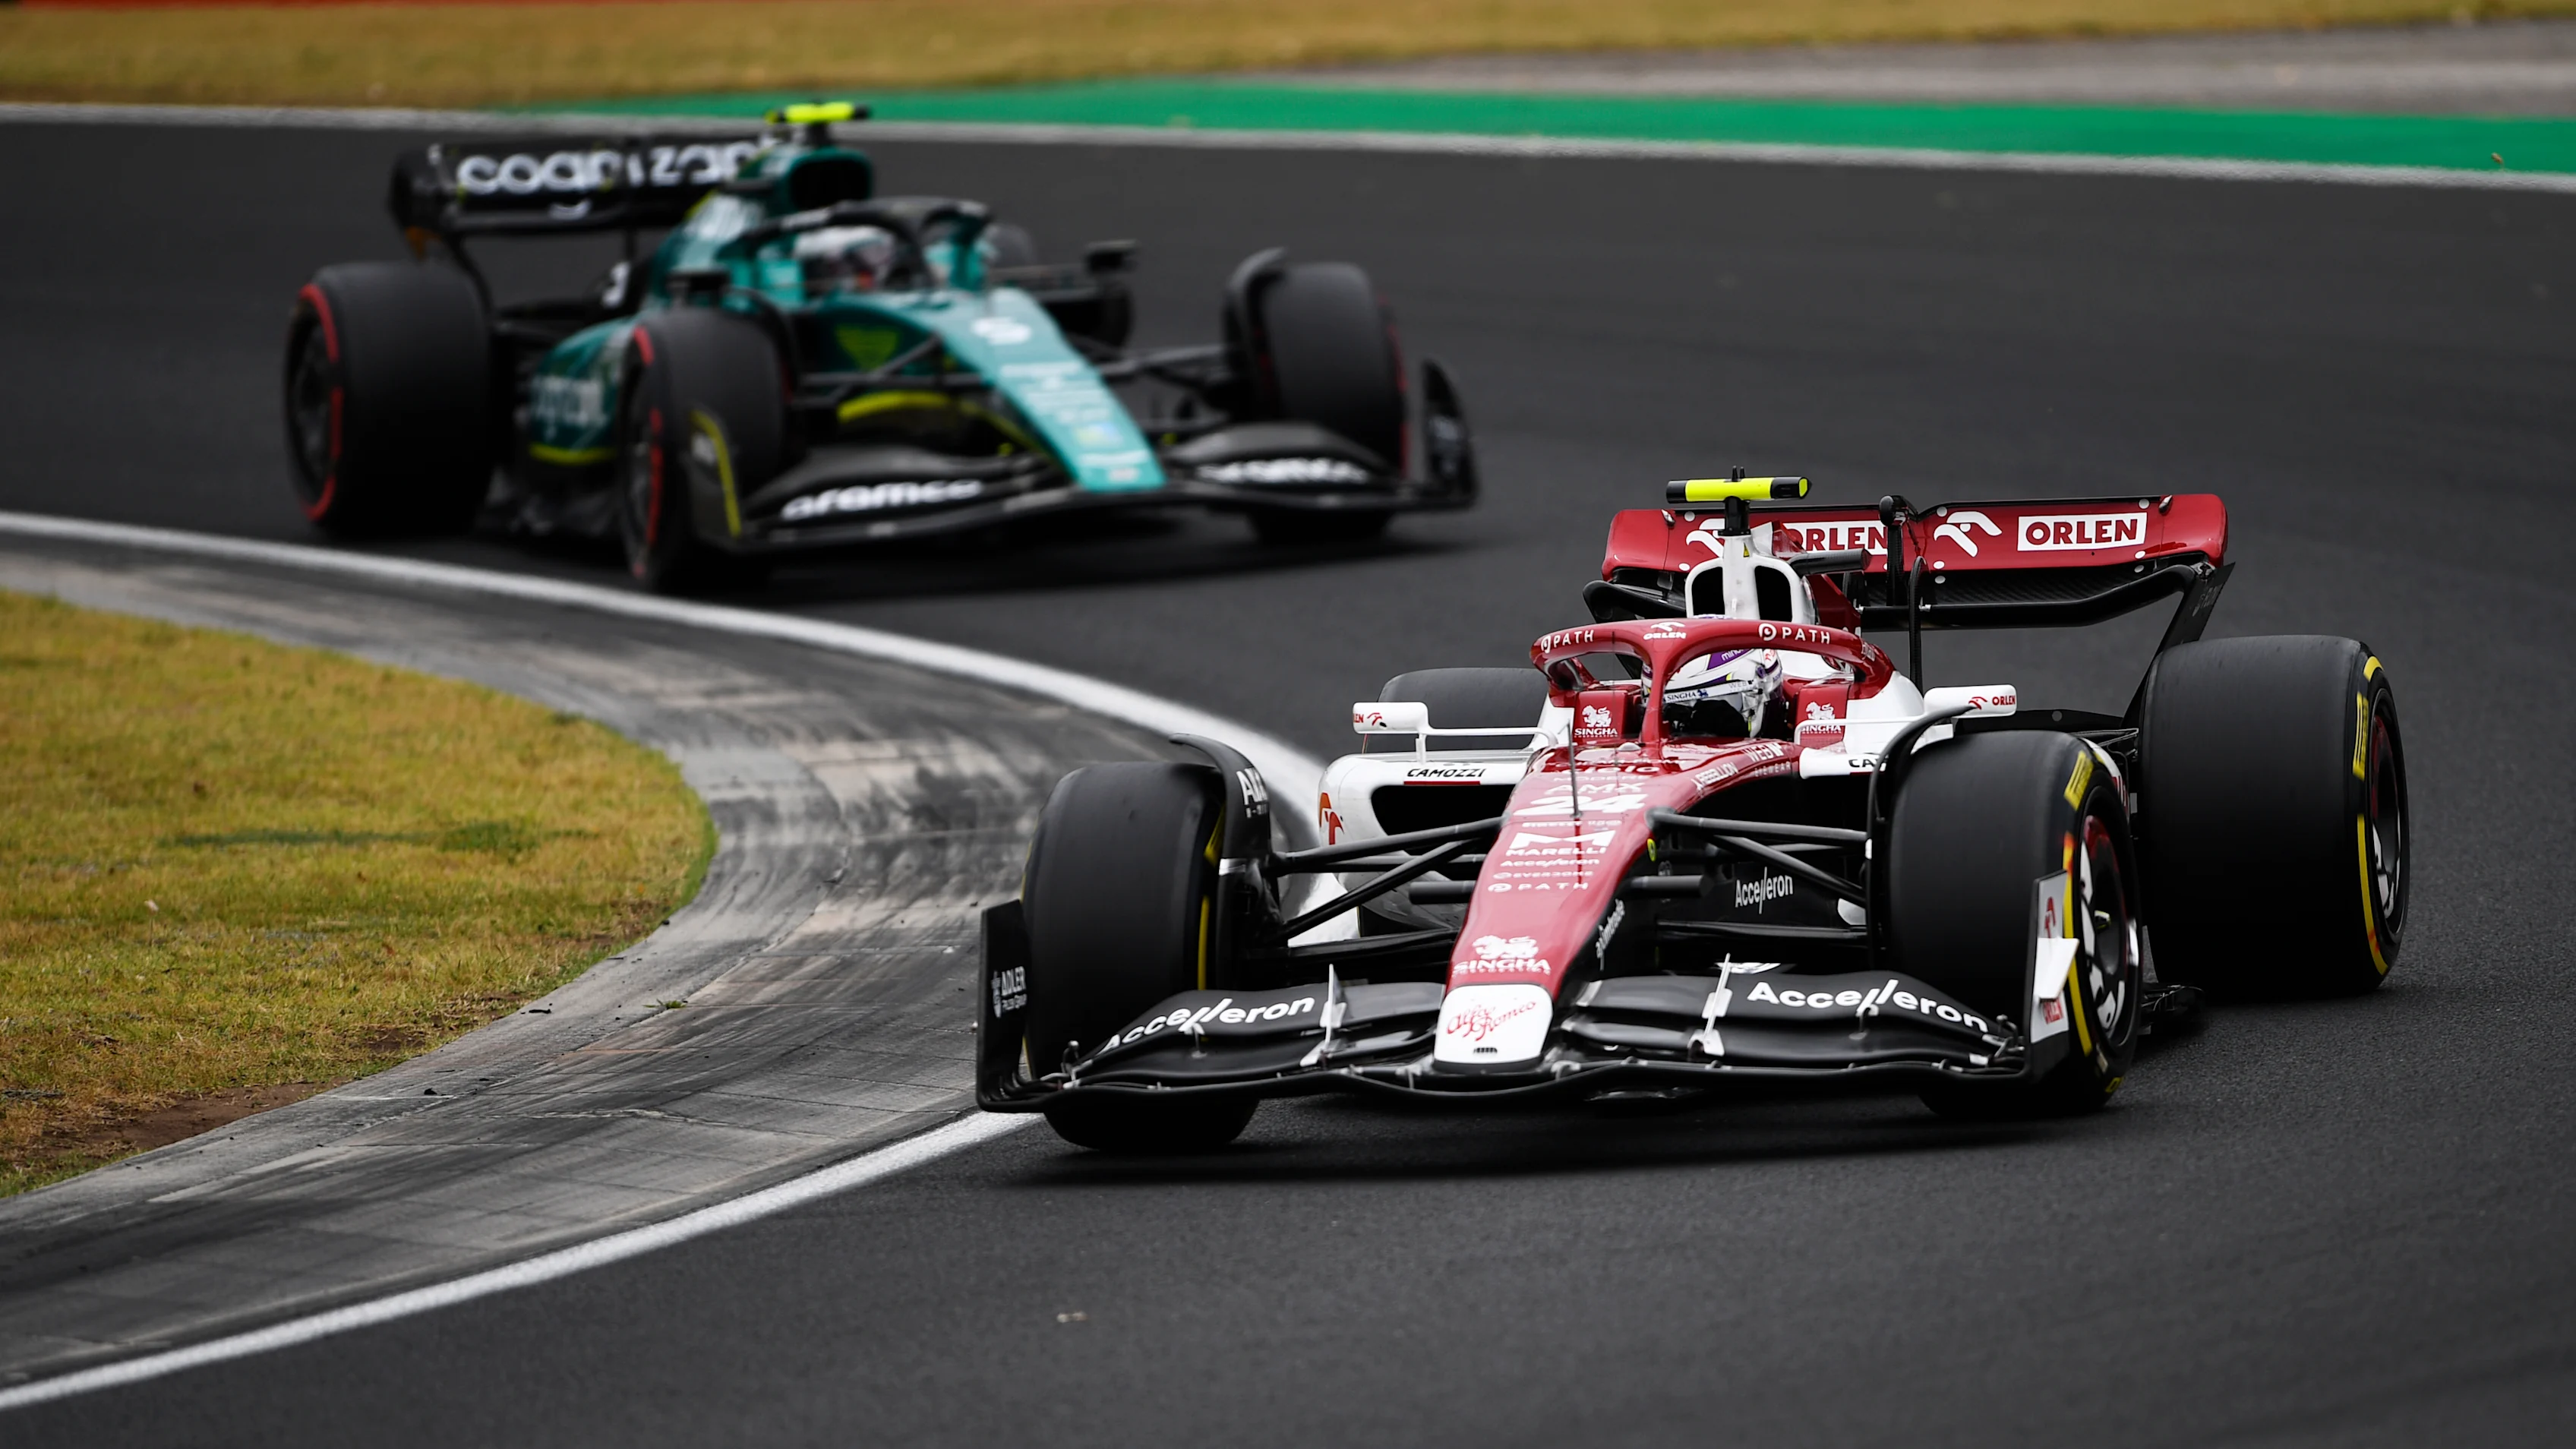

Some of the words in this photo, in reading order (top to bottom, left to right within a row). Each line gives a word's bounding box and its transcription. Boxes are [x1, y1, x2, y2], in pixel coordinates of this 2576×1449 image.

[2025, 519, 2138, 545] ORLEN
[1553, 629, 1594, 648] PATH
[1643, 632, 1687, 640] ORLEN
[1782, 626, 1830, 644] PATH
[1666, 692, 1697, 701] SINGHA
[1992, 695, 2016, 706] ORLEN
[1574, 728, 1618, 736] SINGHA
[1406, 768, 1487, 778] CAMOZZI
[1544, 782, 1646, 795] AMX
[1513, 794, 1649, 816] 24
[1505, 847, 1607, 857] MARELLI
[1518, 882, 1589, 891] PATH
[1454, 958, 1552, 974] SINGHA
[1747, 980, 1988, 1033] Accelleron
[1099, 996, 1315, 1055] Accelleron
